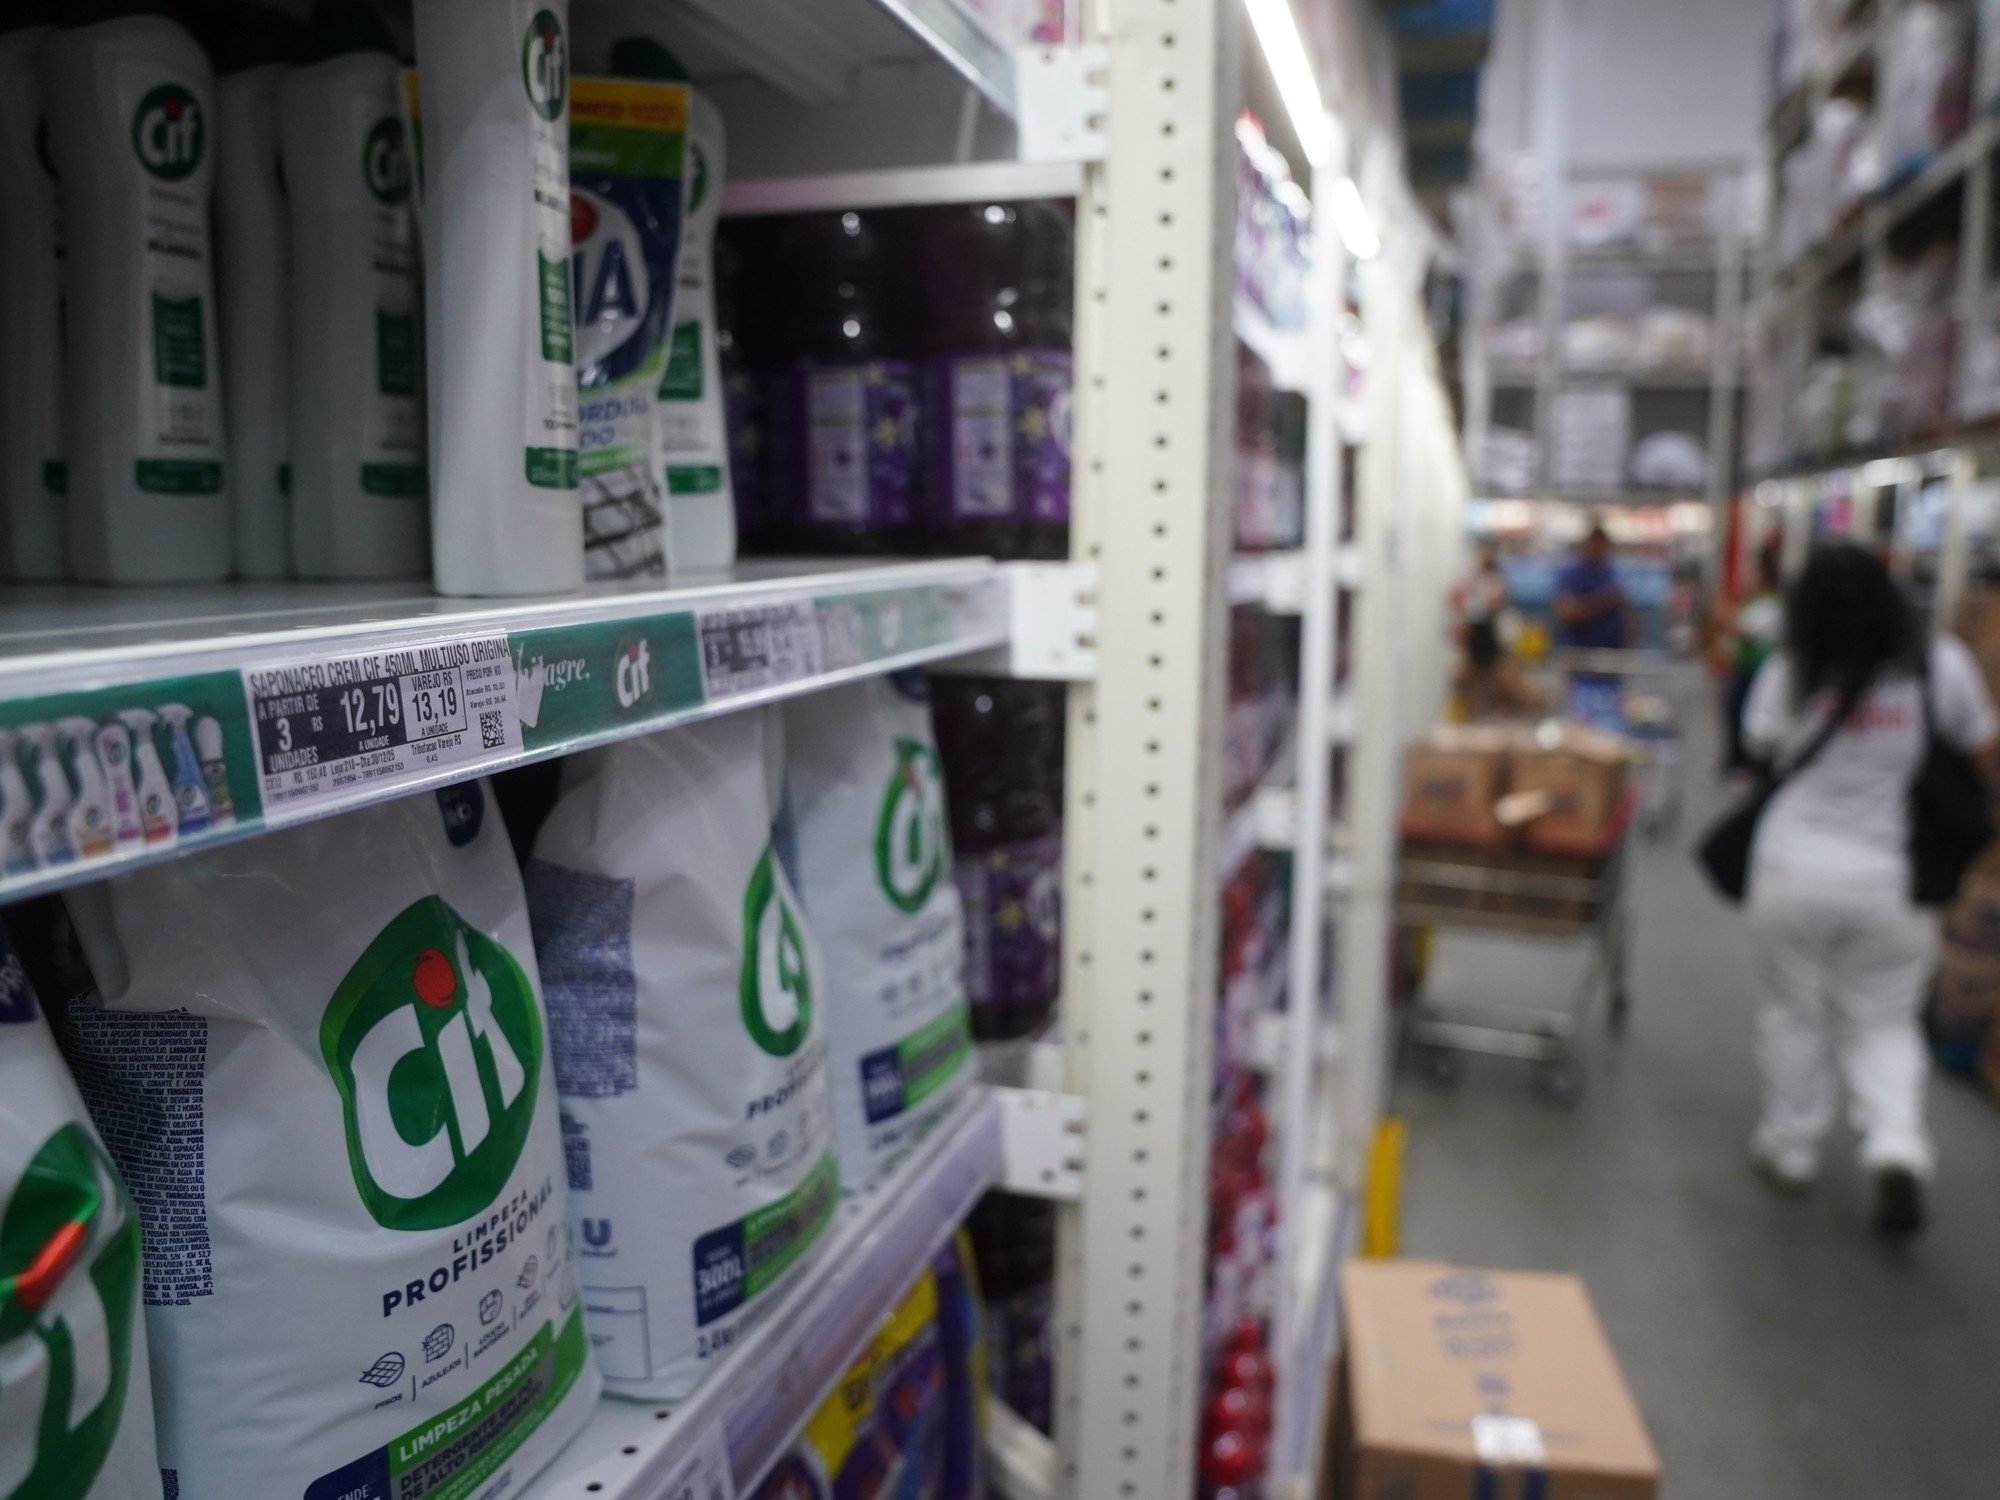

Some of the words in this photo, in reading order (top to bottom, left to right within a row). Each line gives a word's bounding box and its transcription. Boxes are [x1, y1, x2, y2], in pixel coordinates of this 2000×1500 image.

[529, 23, 565, 104] Cif
[141, 97, 197, 167] Cif
[250, 664, 326, 700] SAPONACEO
[327, 658, 362, 687] CREM
[363, 655, 382, 681] CIF
[384, 651, 419, 679] 450ML
[419, 644, 471, 673] MULTIUSO
[471, 637, 510, 663] ORIGINA
[412, 672, 441, 692] VAREJO
[616, 638, 651, 708] Cif
[257, 701, 268, 721] A
[268, 696, 306, 718] PARTIR
[307, 692, 320, 713] DE
[341, 683, 400, 736] 12,79
[412, 687, 457, 723] 13,19
[421, 727, 428, 738] A
[427, 722, 449, 736] UNIDADE
[269, 745, 319, 774] UNIDADES
[277, 716, 293, 752] 3
[359, 740, 367, 752] A
[366, 734, 390, 750] UNIDADE
[350, 929, 525, 1200] Cif
[383, 1180, 552, 1317] PROFISSIONAL
[454, 1190, 527, 1254] LIMPEZA
[375, 1393, 403, 1409] PISOS
[422, 1356, 462, 1389] AZULEJOS
[399, 1399, 482, 1463] LIMPEZA
